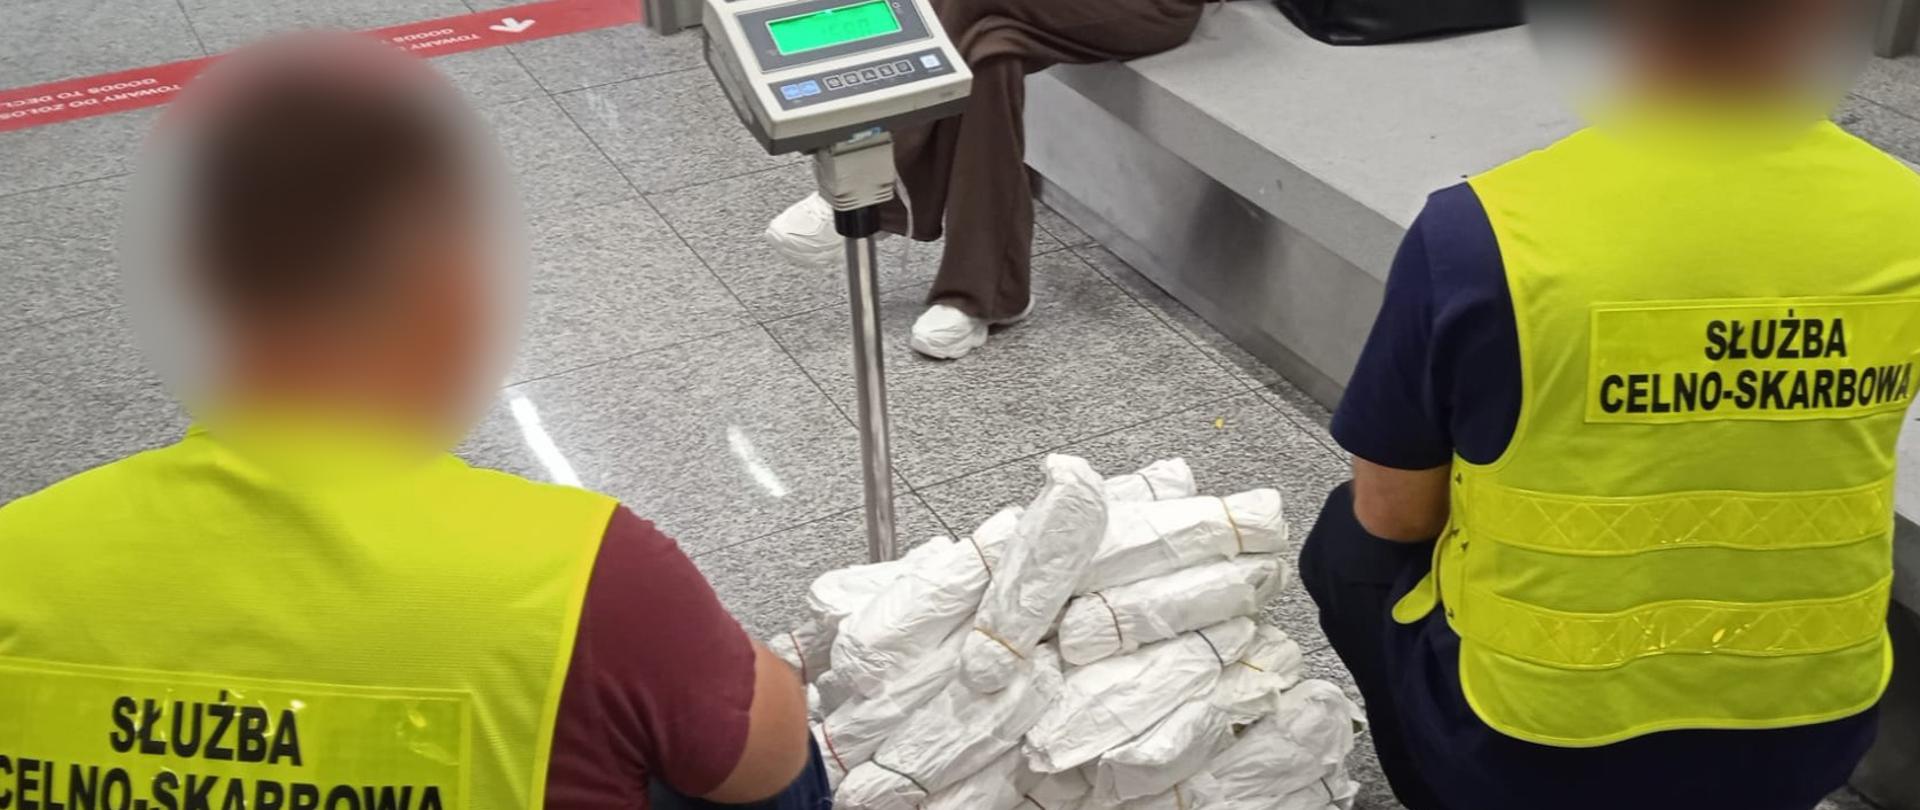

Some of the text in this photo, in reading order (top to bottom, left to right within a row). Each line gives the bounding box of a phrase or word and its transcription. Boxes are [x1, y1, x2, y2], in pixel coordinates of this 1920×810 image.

[392, 28, 454, 42] GOODS
[411, 34, 480, 50] TOWARY
[88, 78, 157, 94] GOODS
[103, 84, 182, 102] TOWARY
[57, 90, 85, 99] TO
[69, 98, 99, 108] DO
[1704, 309, 1847, 361] SŁUŻBA
[1600, 362, 1912, 413] CELNO-SKARBOWA
[109, 689, 303, 766] SŁUŻBA
